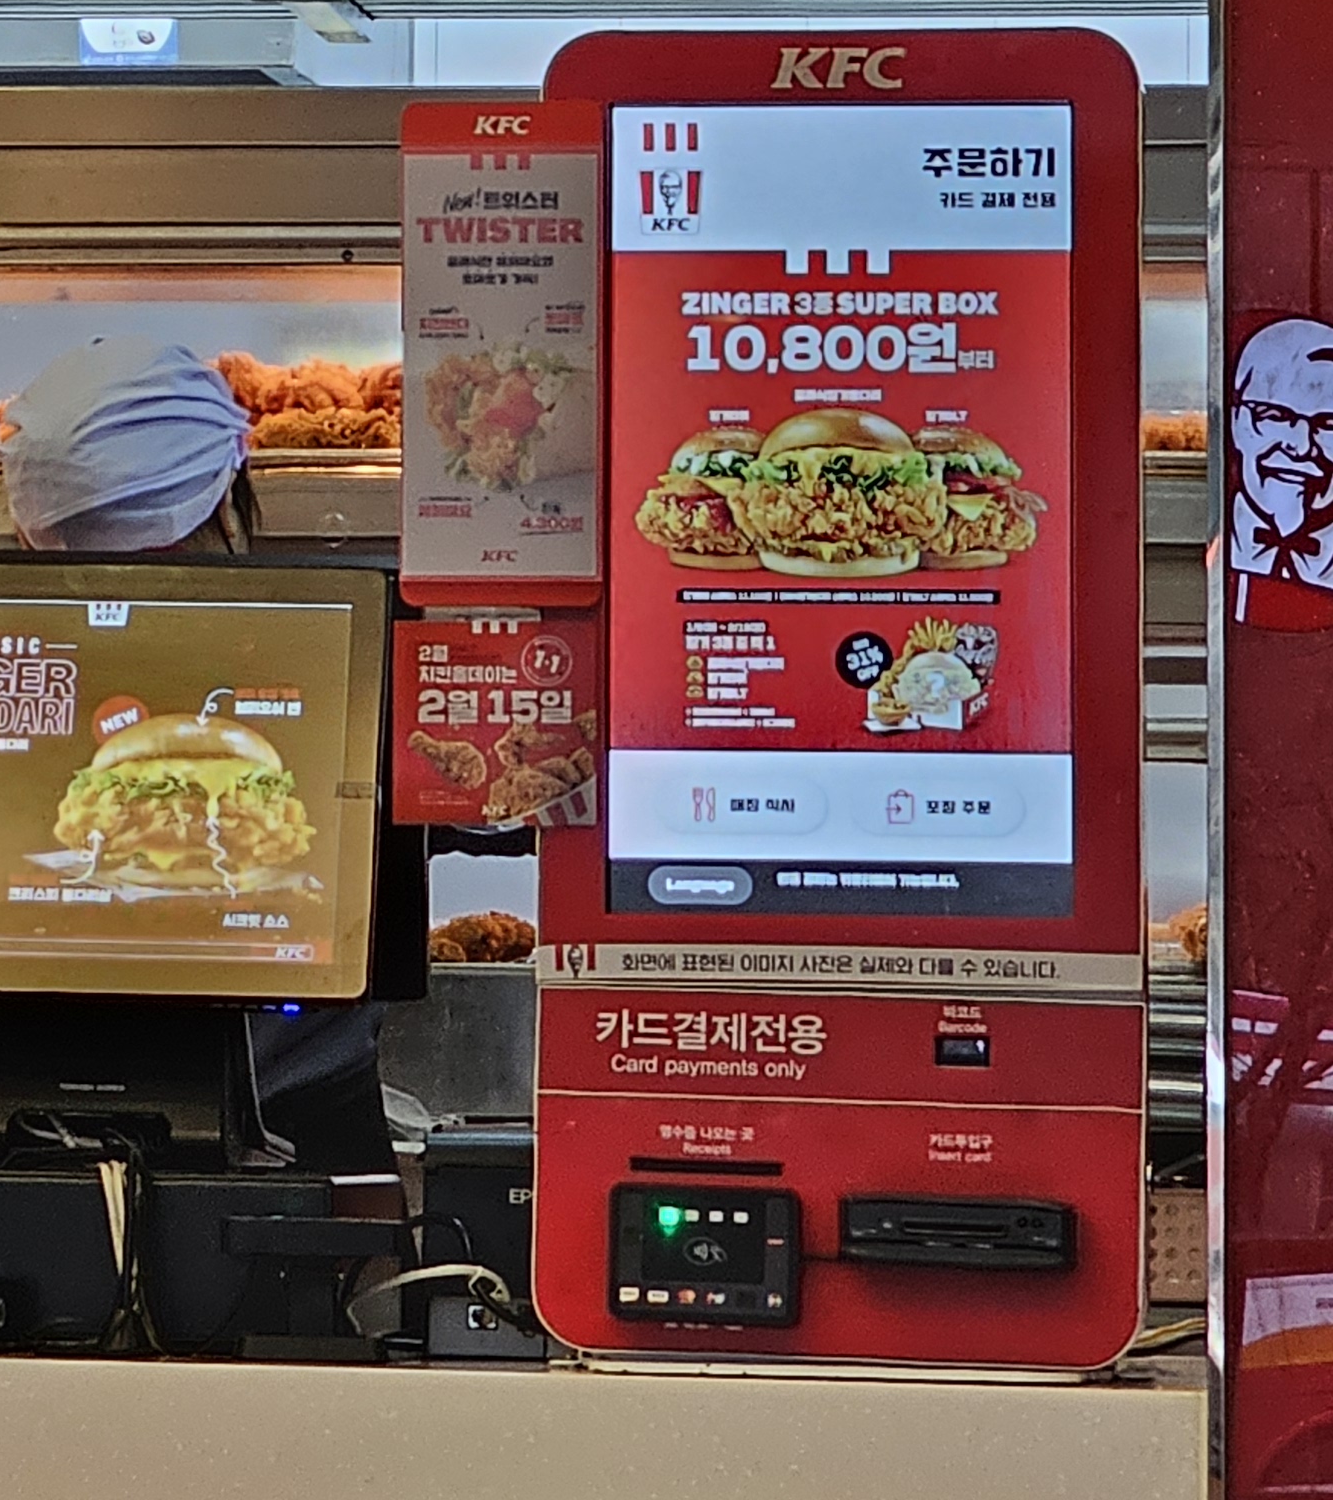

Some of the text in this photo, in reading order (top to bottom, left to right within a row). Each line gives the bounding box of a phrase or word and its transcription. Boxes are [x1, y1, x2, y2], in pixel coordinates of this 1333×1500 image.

[770, 46, 907, 90] KFC
[473, 115, 531, 136] KFC
[922, 147, 1056, 178] 주문하기
[483, 190, 560, 210] 트위스터
[939, 192, 1056, 209] 카드 결제 전용
[416, 216, 585, 245] TWISTER
[651, 217, 691, 232] KFC
[681, 292, 790, 315] ZINGER
[836, 292, 933, 315] SUPER
[938, 292, 999, 315] BOX
[418, 644, 449, 663] 2월
[417, 689, 573, 725] 2월 15일
[99, 707, 139, 736] NEW
[621, 953, 1062, 980] 화면에 표현된 이미지 사진은 실제와 다를 수 있습니다.
[942, 1004, 983, 1019] 바코드
[594, 1010, 828, 1055] 카드결제전용
[611, 1054, 807, 1081] Card payments only
